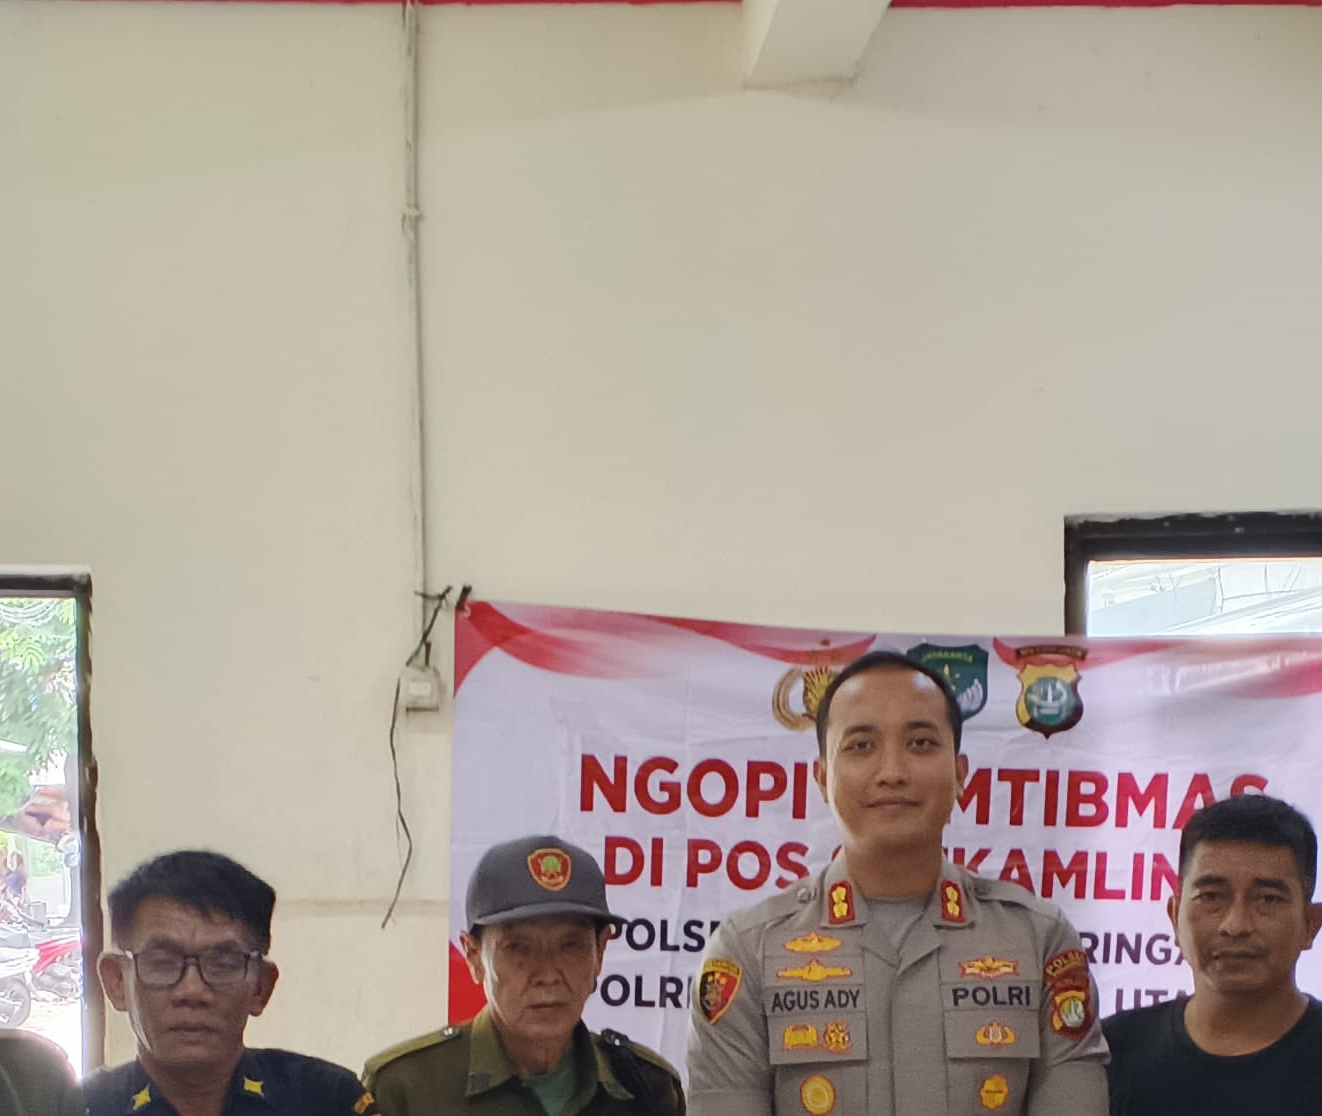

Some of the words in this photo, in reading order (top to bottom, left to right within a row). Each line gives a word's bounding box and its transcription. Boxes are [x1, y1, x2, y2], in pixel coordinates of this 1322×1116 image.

[580, 753, 808, 820] NGOPI
[944, 768, 1269, 829] MTIBMA
[604, 835, 664, 887] DI
[686, 838, 810, 890] POS
[772, 993, 819, 1013] AGUS
[824, 990, 861, 1009] ADY
[952, 986, 1031, 1007] POLRI
